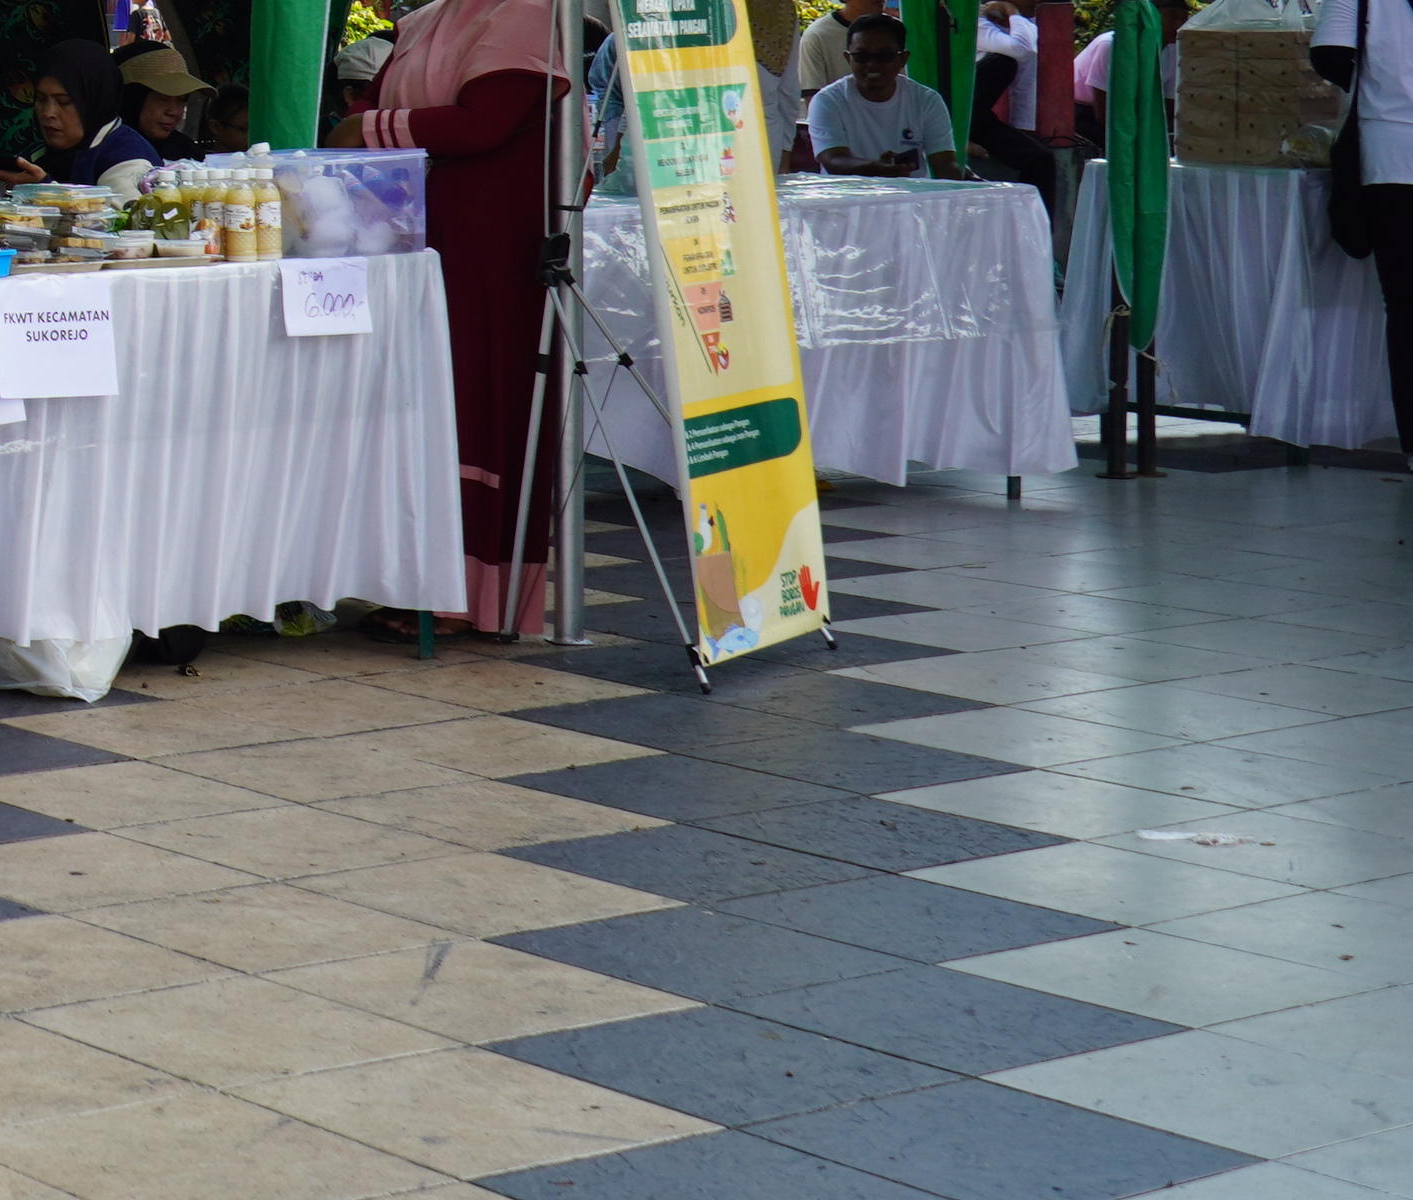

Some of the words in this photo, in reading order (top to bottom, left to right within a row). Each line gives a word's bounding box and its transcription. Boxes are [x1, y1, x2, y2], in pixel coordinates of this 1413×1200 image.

[4, 312, 33, 324] FKWT
[37, 310, 110, 323] KECAMATAN
[26, 329, 88, 342] SUKOREJO
